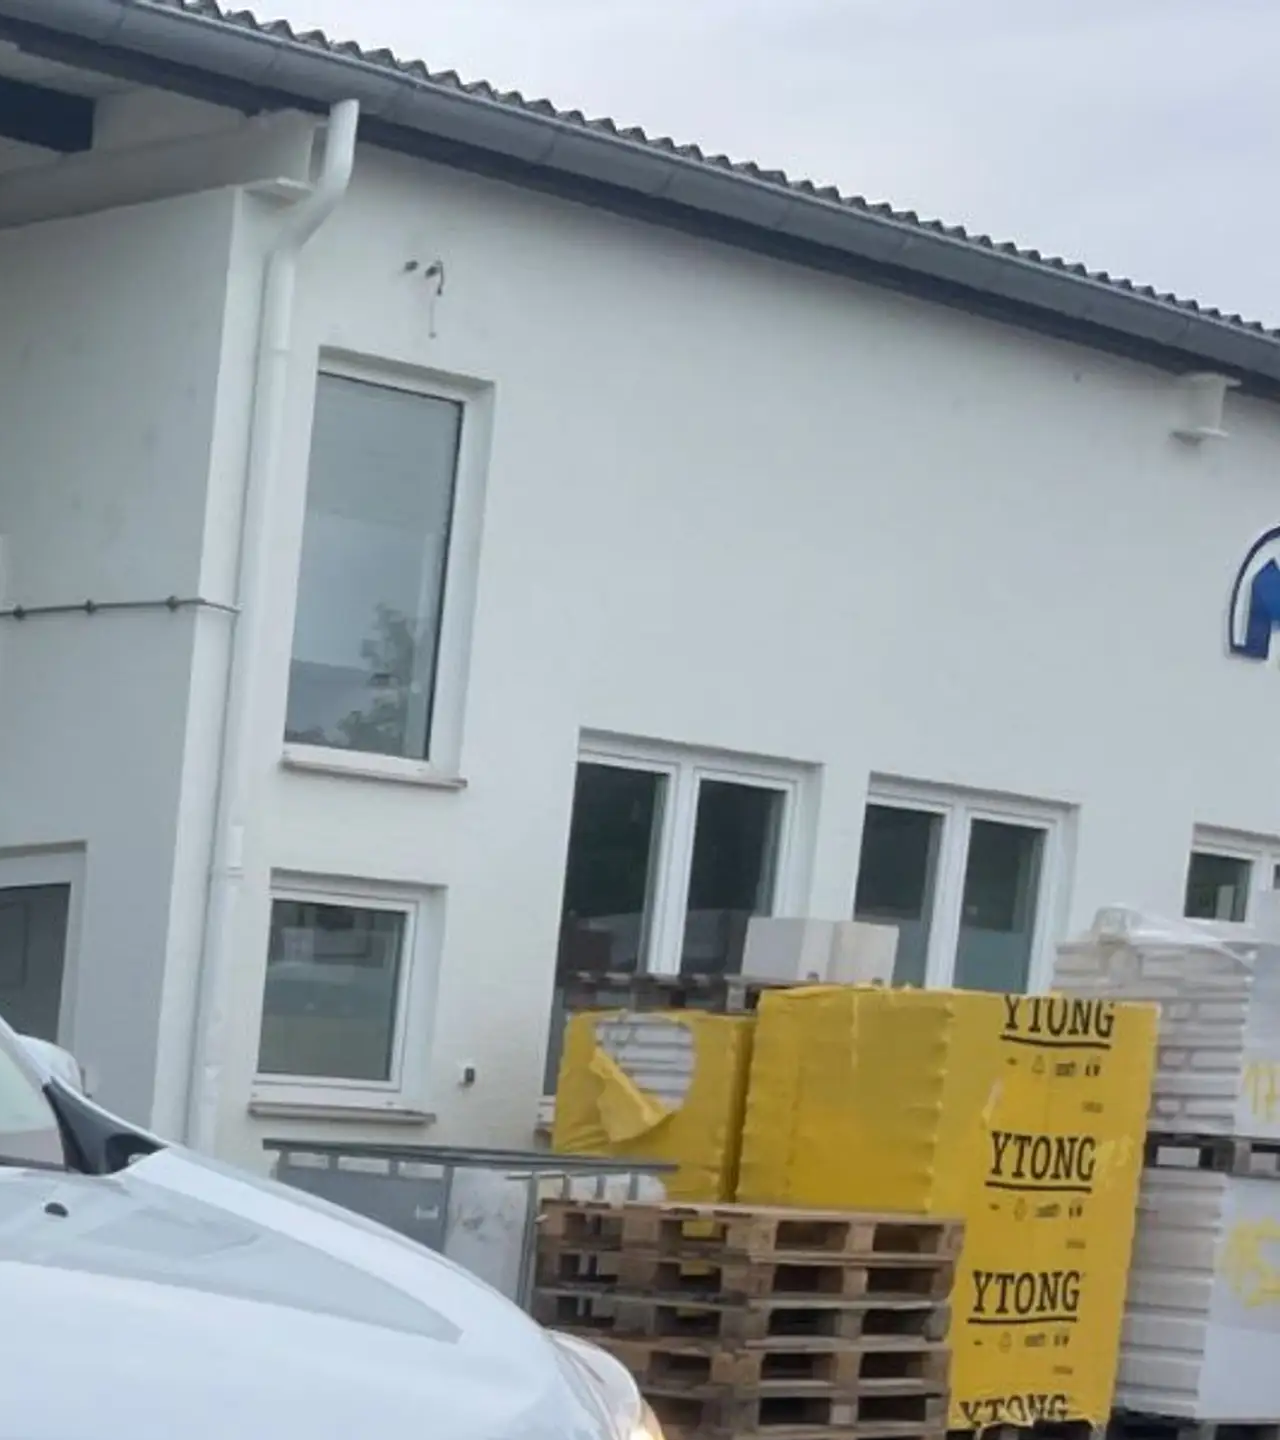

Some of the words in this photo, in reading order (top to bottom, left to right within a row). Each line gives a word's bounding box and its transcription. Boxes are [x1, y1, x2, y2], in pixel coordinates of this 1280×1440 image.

[1004, 994, 1115, 1038] YTONG
[991, 1130, 1096, 1181] YTONG
[972, 1270, 1080, 1315] YTONG
